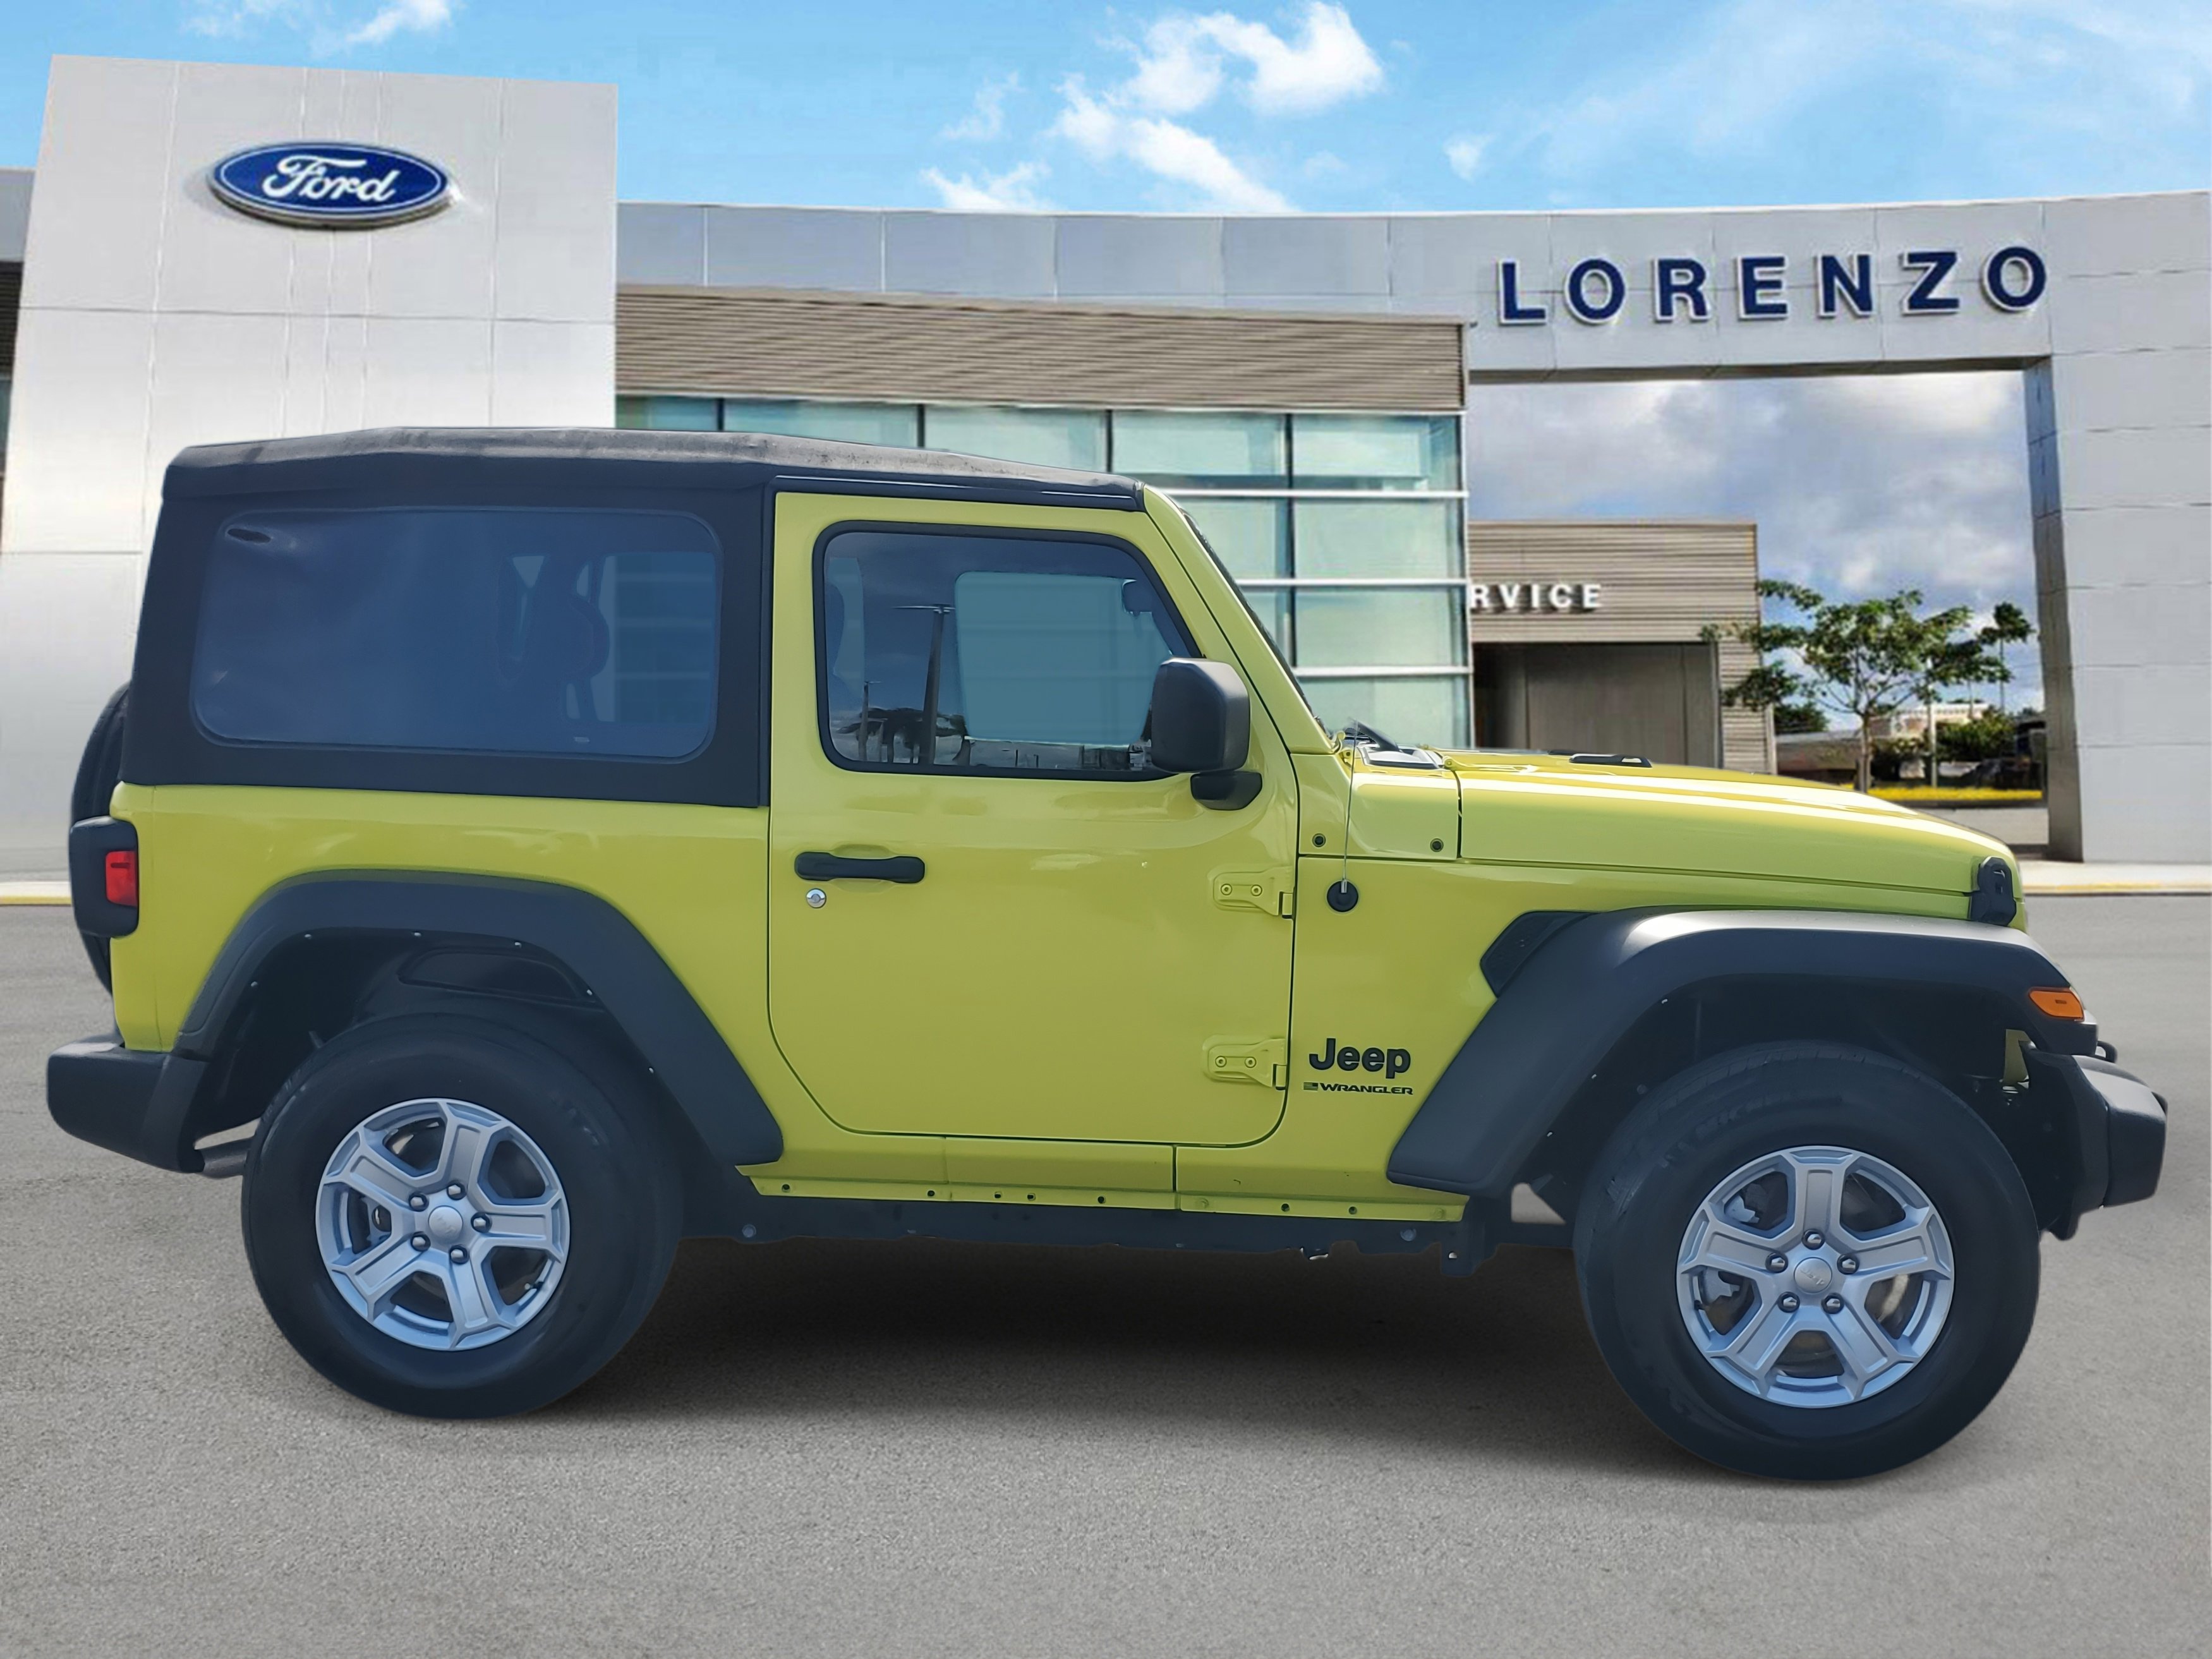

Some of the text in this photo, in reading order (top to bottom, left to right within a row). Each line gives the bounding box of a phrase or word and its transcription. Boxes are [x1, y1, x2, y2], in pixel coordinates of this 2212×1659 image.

[263, 154, 401, 202] Ford
[1498, 246, 2048, 325] LORENZO
[1309, 1037, 1411, 1079] Jeep
[1319, 1082, 1413, 1095] WRANGLER
